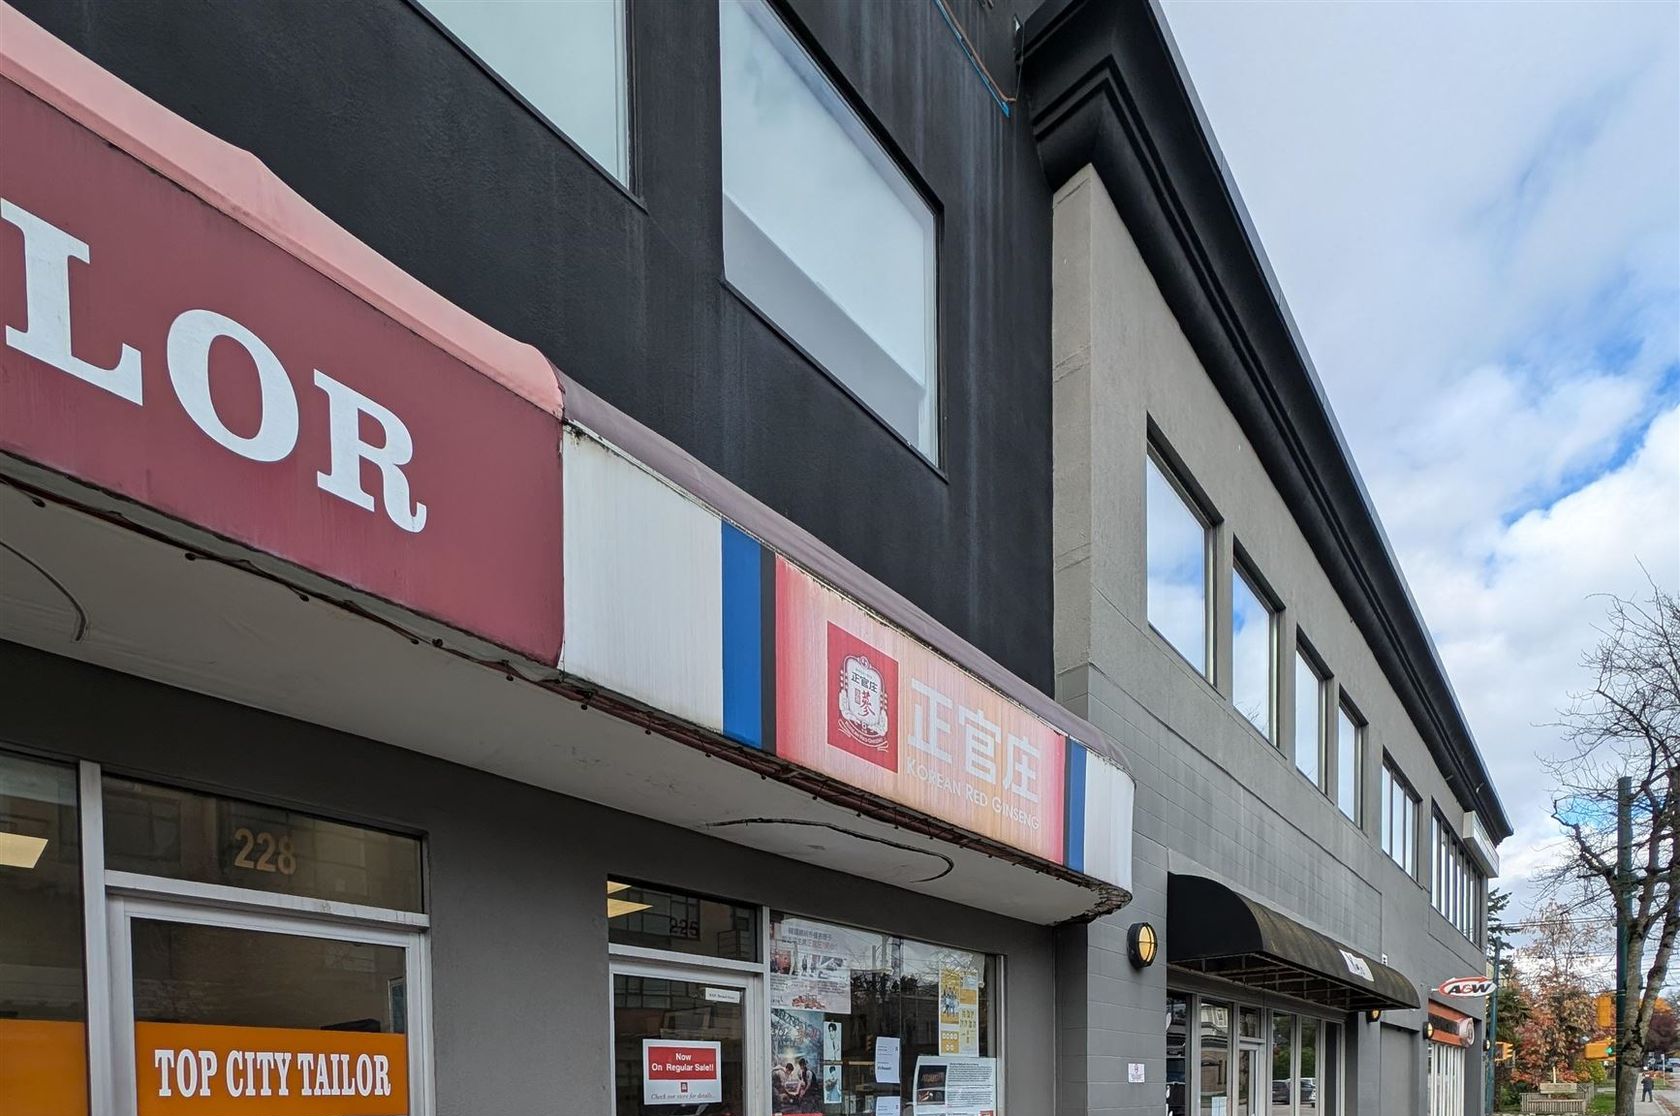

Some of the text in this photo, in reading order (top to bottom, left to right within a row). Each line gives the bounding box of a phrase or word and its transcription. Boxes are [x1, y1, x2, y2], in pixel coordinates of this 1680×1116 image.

[0, 197, 428, 534] LOR
[908, 678, 1041, 803] 正官庄
[906, 757, 1040, 830] KOREAN RED GINSENG
[233, 827, 297, 876] 228
[1448, 983, 1491, 994] A&W
[154, 1049, 391, 1097] TOP CITY TAILOR
[651, 1063, 714, 1073] On Regular Sale!!
[675, 1053, 692, 1061] Now
